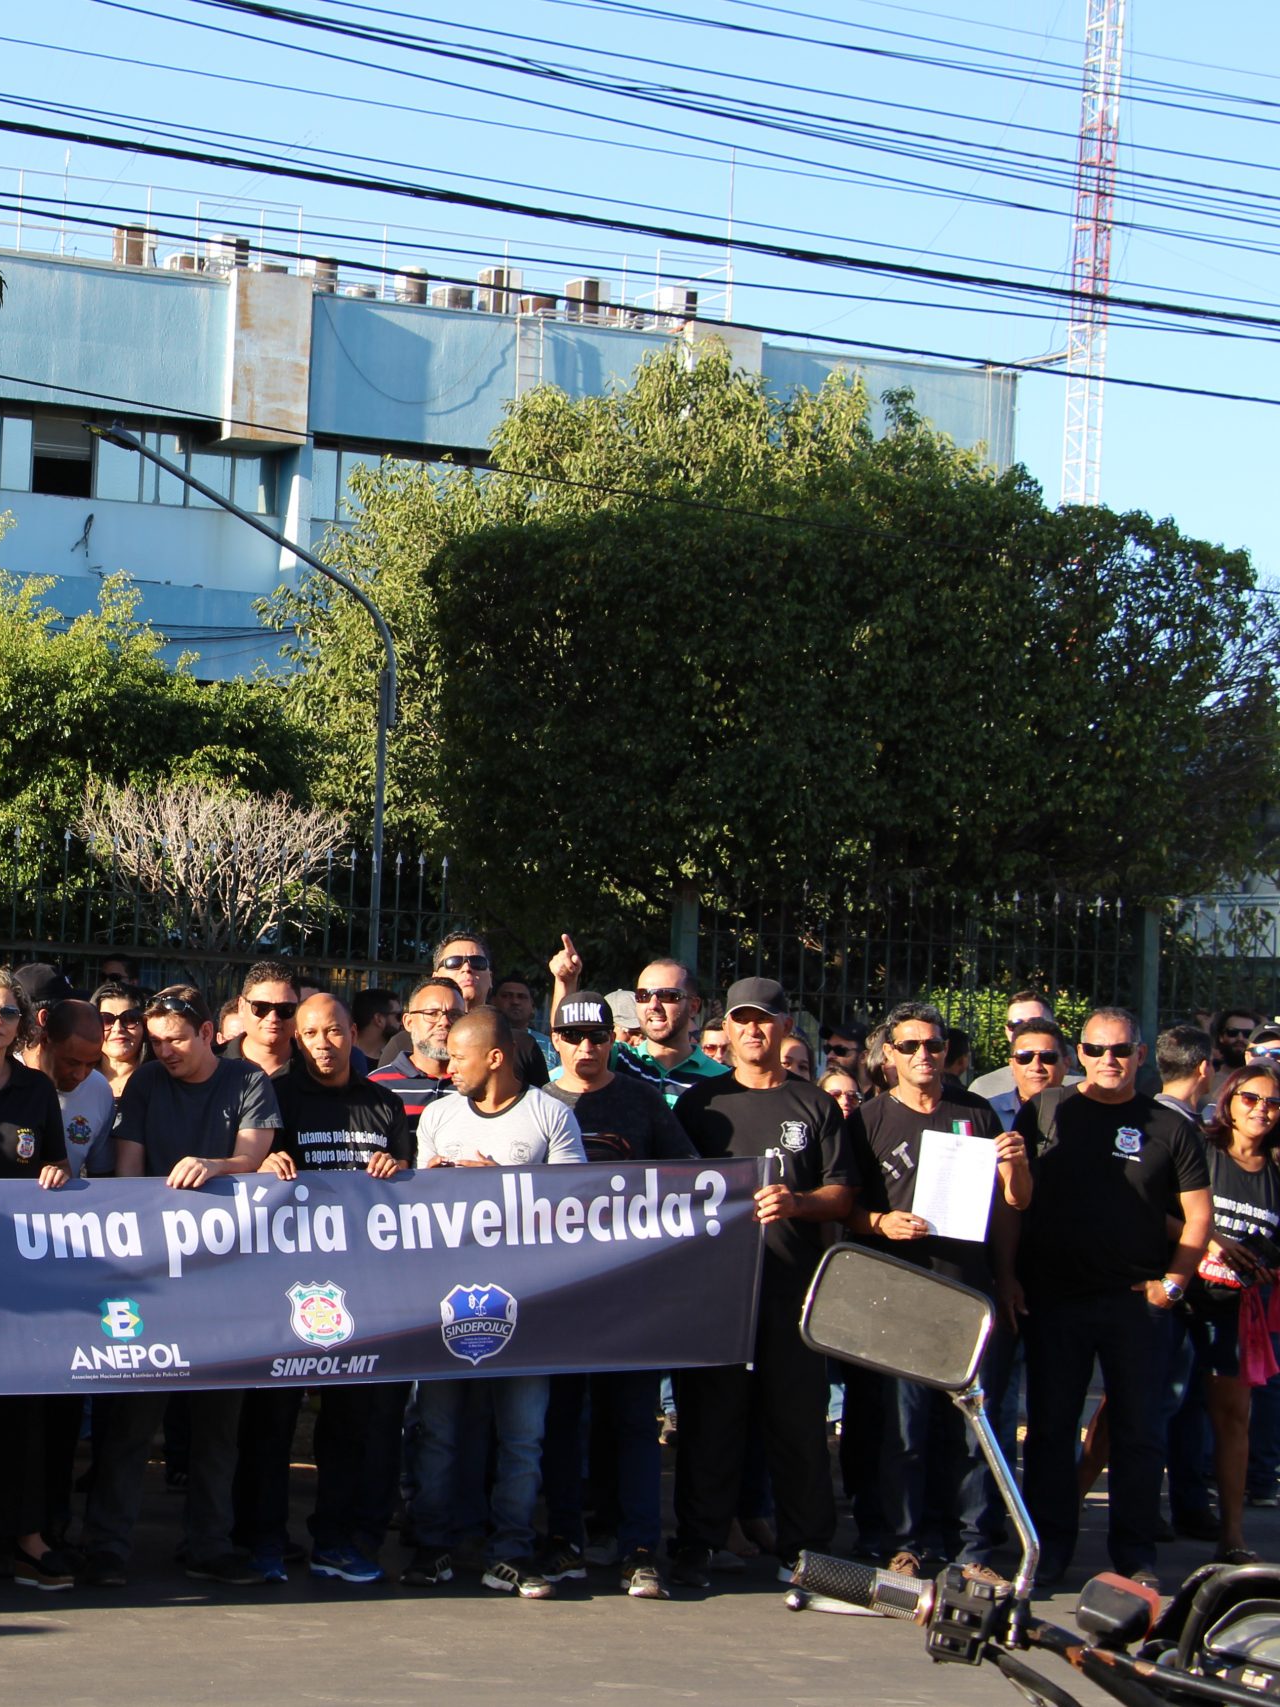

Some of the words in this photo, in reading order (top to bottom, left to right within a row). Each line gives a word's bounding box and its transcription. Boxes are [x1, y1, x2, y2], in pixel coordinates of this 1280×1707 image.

[297, 1131, 332, 1145] Lutamos
[332, 1128, 351, 1143] pela
[350, 1130, 387, 1148] sociedade
[304, 1151, 311, 1163] e
[311, 1150, 335, 1164] agora
[336, 1148, 353, 1162] pelo
[13, 1208, 143, 1260] uma
[162, 1182, 347, 1278] polícia
[367, 1168, 727, 1251] envelhecida?
[445, 1321, 511, 1338] SINDEPOJUC
[71, 1343, 190, 1370] ANEPOL
[270, 1355, 379, 1377] SINPOL-MT
